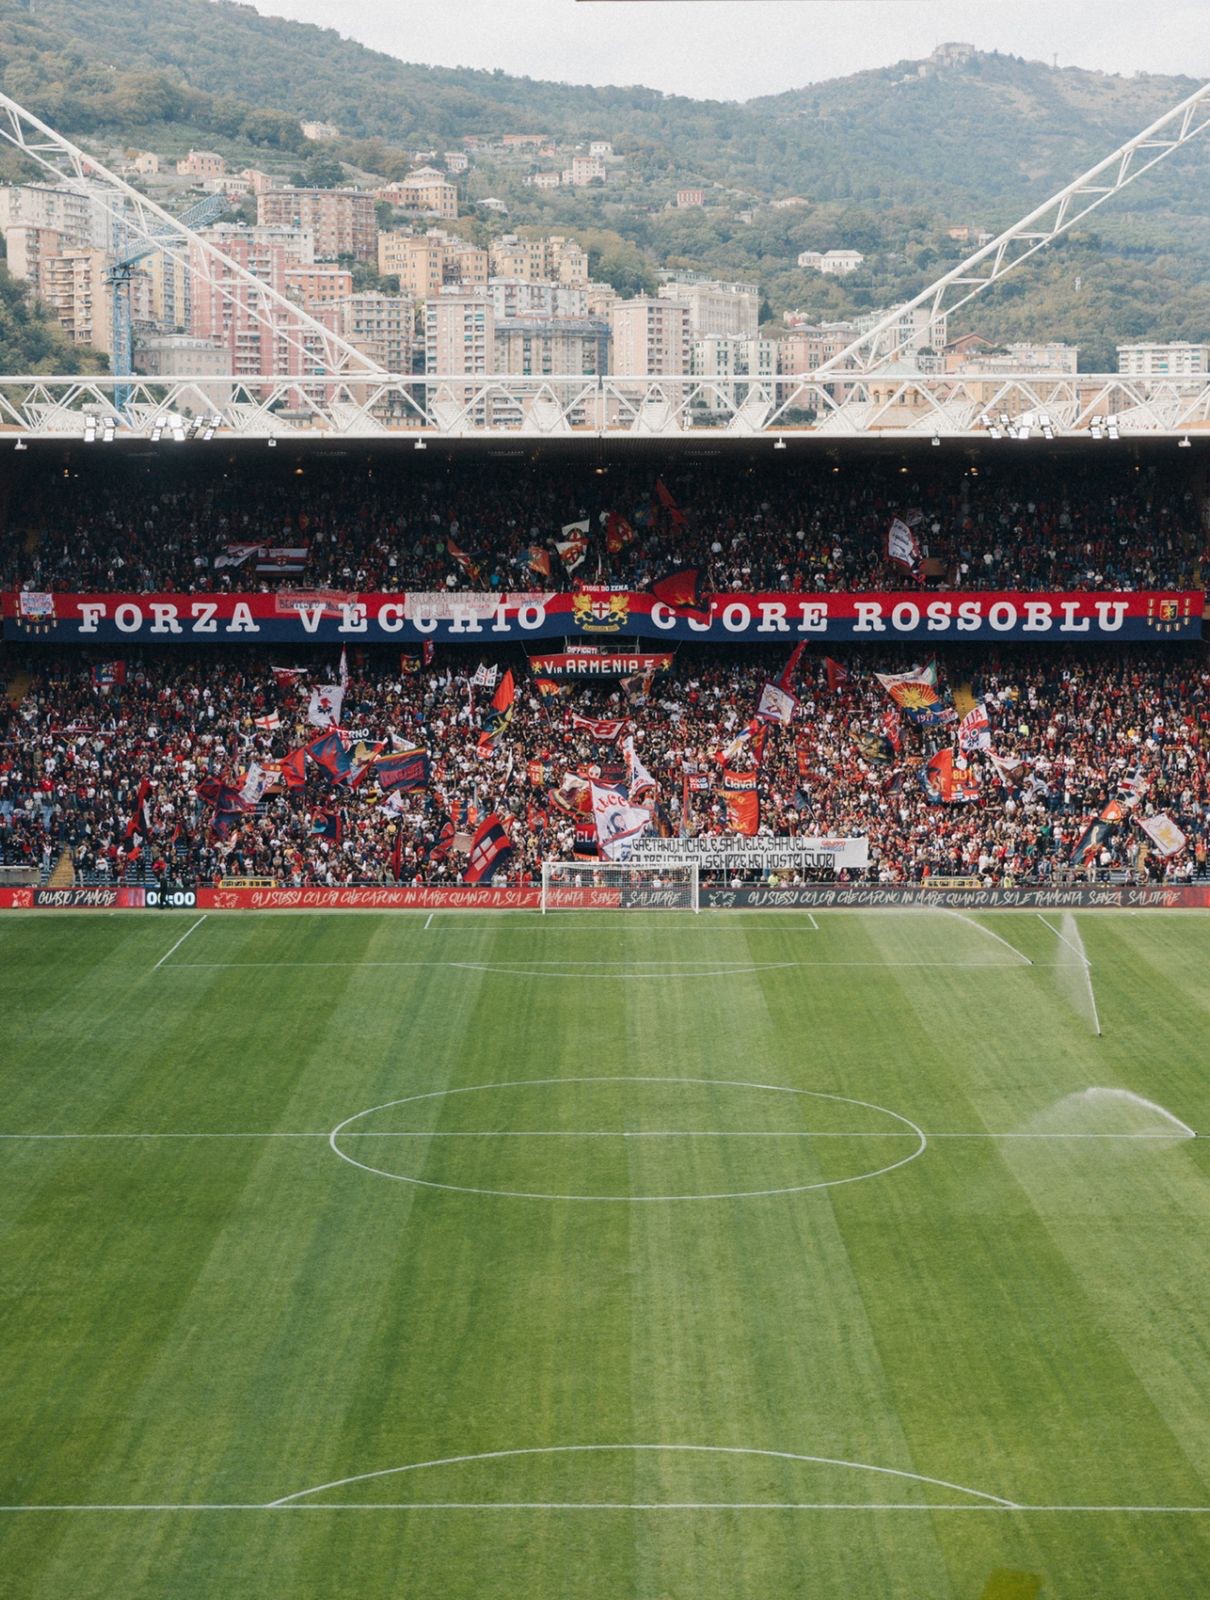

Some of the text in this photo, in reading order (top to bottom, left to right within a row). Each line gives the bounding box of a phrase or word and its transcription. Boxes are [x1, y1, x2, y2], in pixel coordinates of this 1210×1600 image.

[77, 602, 260, 633] FORZA
[298, 602, 547, 634] VECCHIO
[651, 602, 829, 632] CUORE
[853, 602, 1128, 632] ROSSOBLU
[566, 659, 639, 674] ARMENIA
[270, 891, 301, 905] STESSI
[301, 891, 338, 905] COLORI
[340, 889, 359, 905] CHE
[359, 891, 402, 906] CADONO
[404, 892, 417, 904] IN
[418, 889, 447, 905] MARE
[449, 891, 491, 906] QUANDO
[493, 891, 505, 906] IL
[505, 891, 535, 905] SOLE
[591, 891, 623, 905] SENZA
[630, 890, 682, 906] SALUTARE
[767, 890, 799, 906] STESSI
[799, 890, 836, 906] COLORI
[837, 889, 856, 905] CHE
[856, 890, 900, 906] CADONO
[901, 891, 914, 904] IN
[915, 889, 944, 905] MARE
[946, 890, 988, 907] QUANDO
[989, 891, 1001, 906] IL
[1001, 890, 1032, 906] SOLE
[1031, 889, 1083, 906] TRAMONTA
[1088, 890, 1122, 906] SENZA
[1128, 890, 1182, 906] SALUTARE
